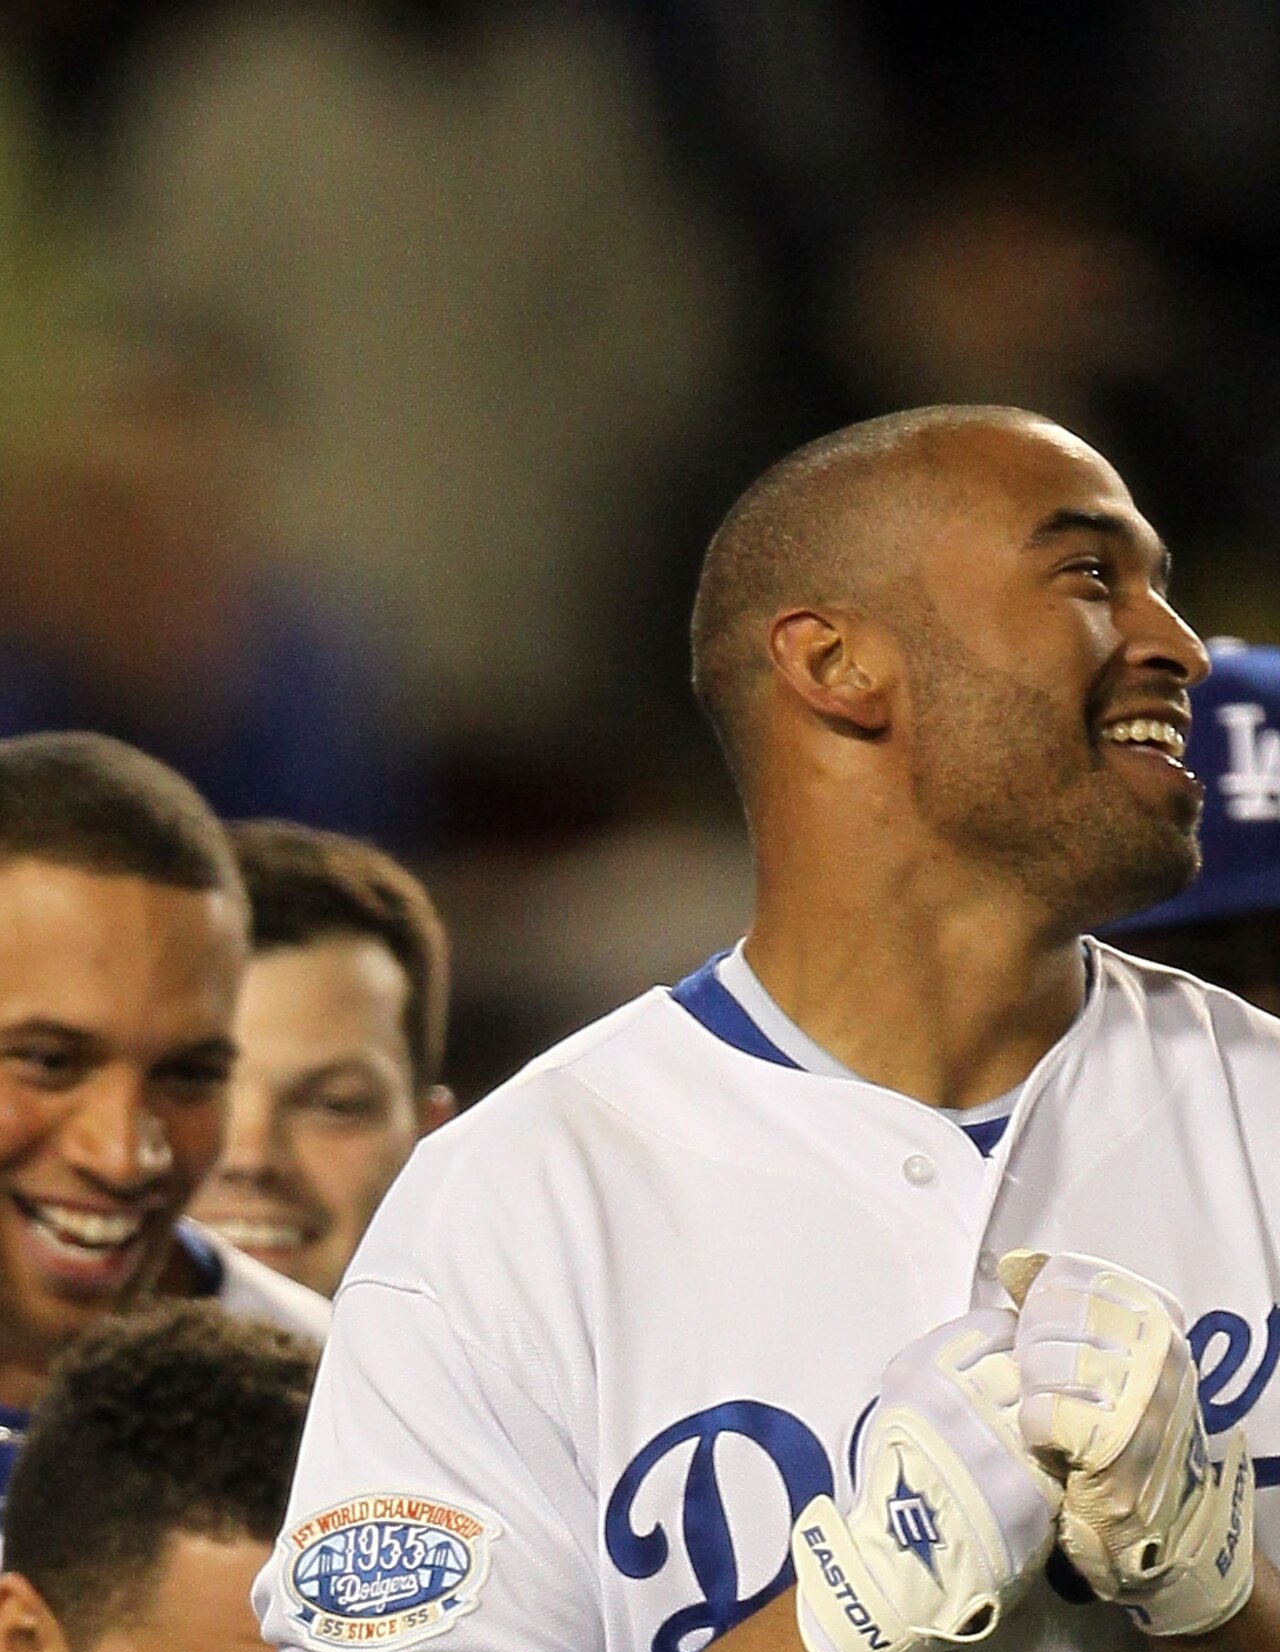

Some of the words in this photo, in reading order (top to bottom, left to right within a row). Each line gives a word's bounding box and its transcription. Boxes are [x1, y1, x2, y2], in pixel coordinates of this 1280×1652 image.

[291, 1524, 315, 1549] 1ST
[318, 1501, 370, 1535] WORLD
[373, 1498, 486, 1541] CHAMPIONSHIP
[342, 1524, 428, 1574] 1955
[335, 1572, 420, 1614] Dodgers
[801, 1524, 893, 1652] EASTON
[347, 1619, 398, 1640] SINCE
